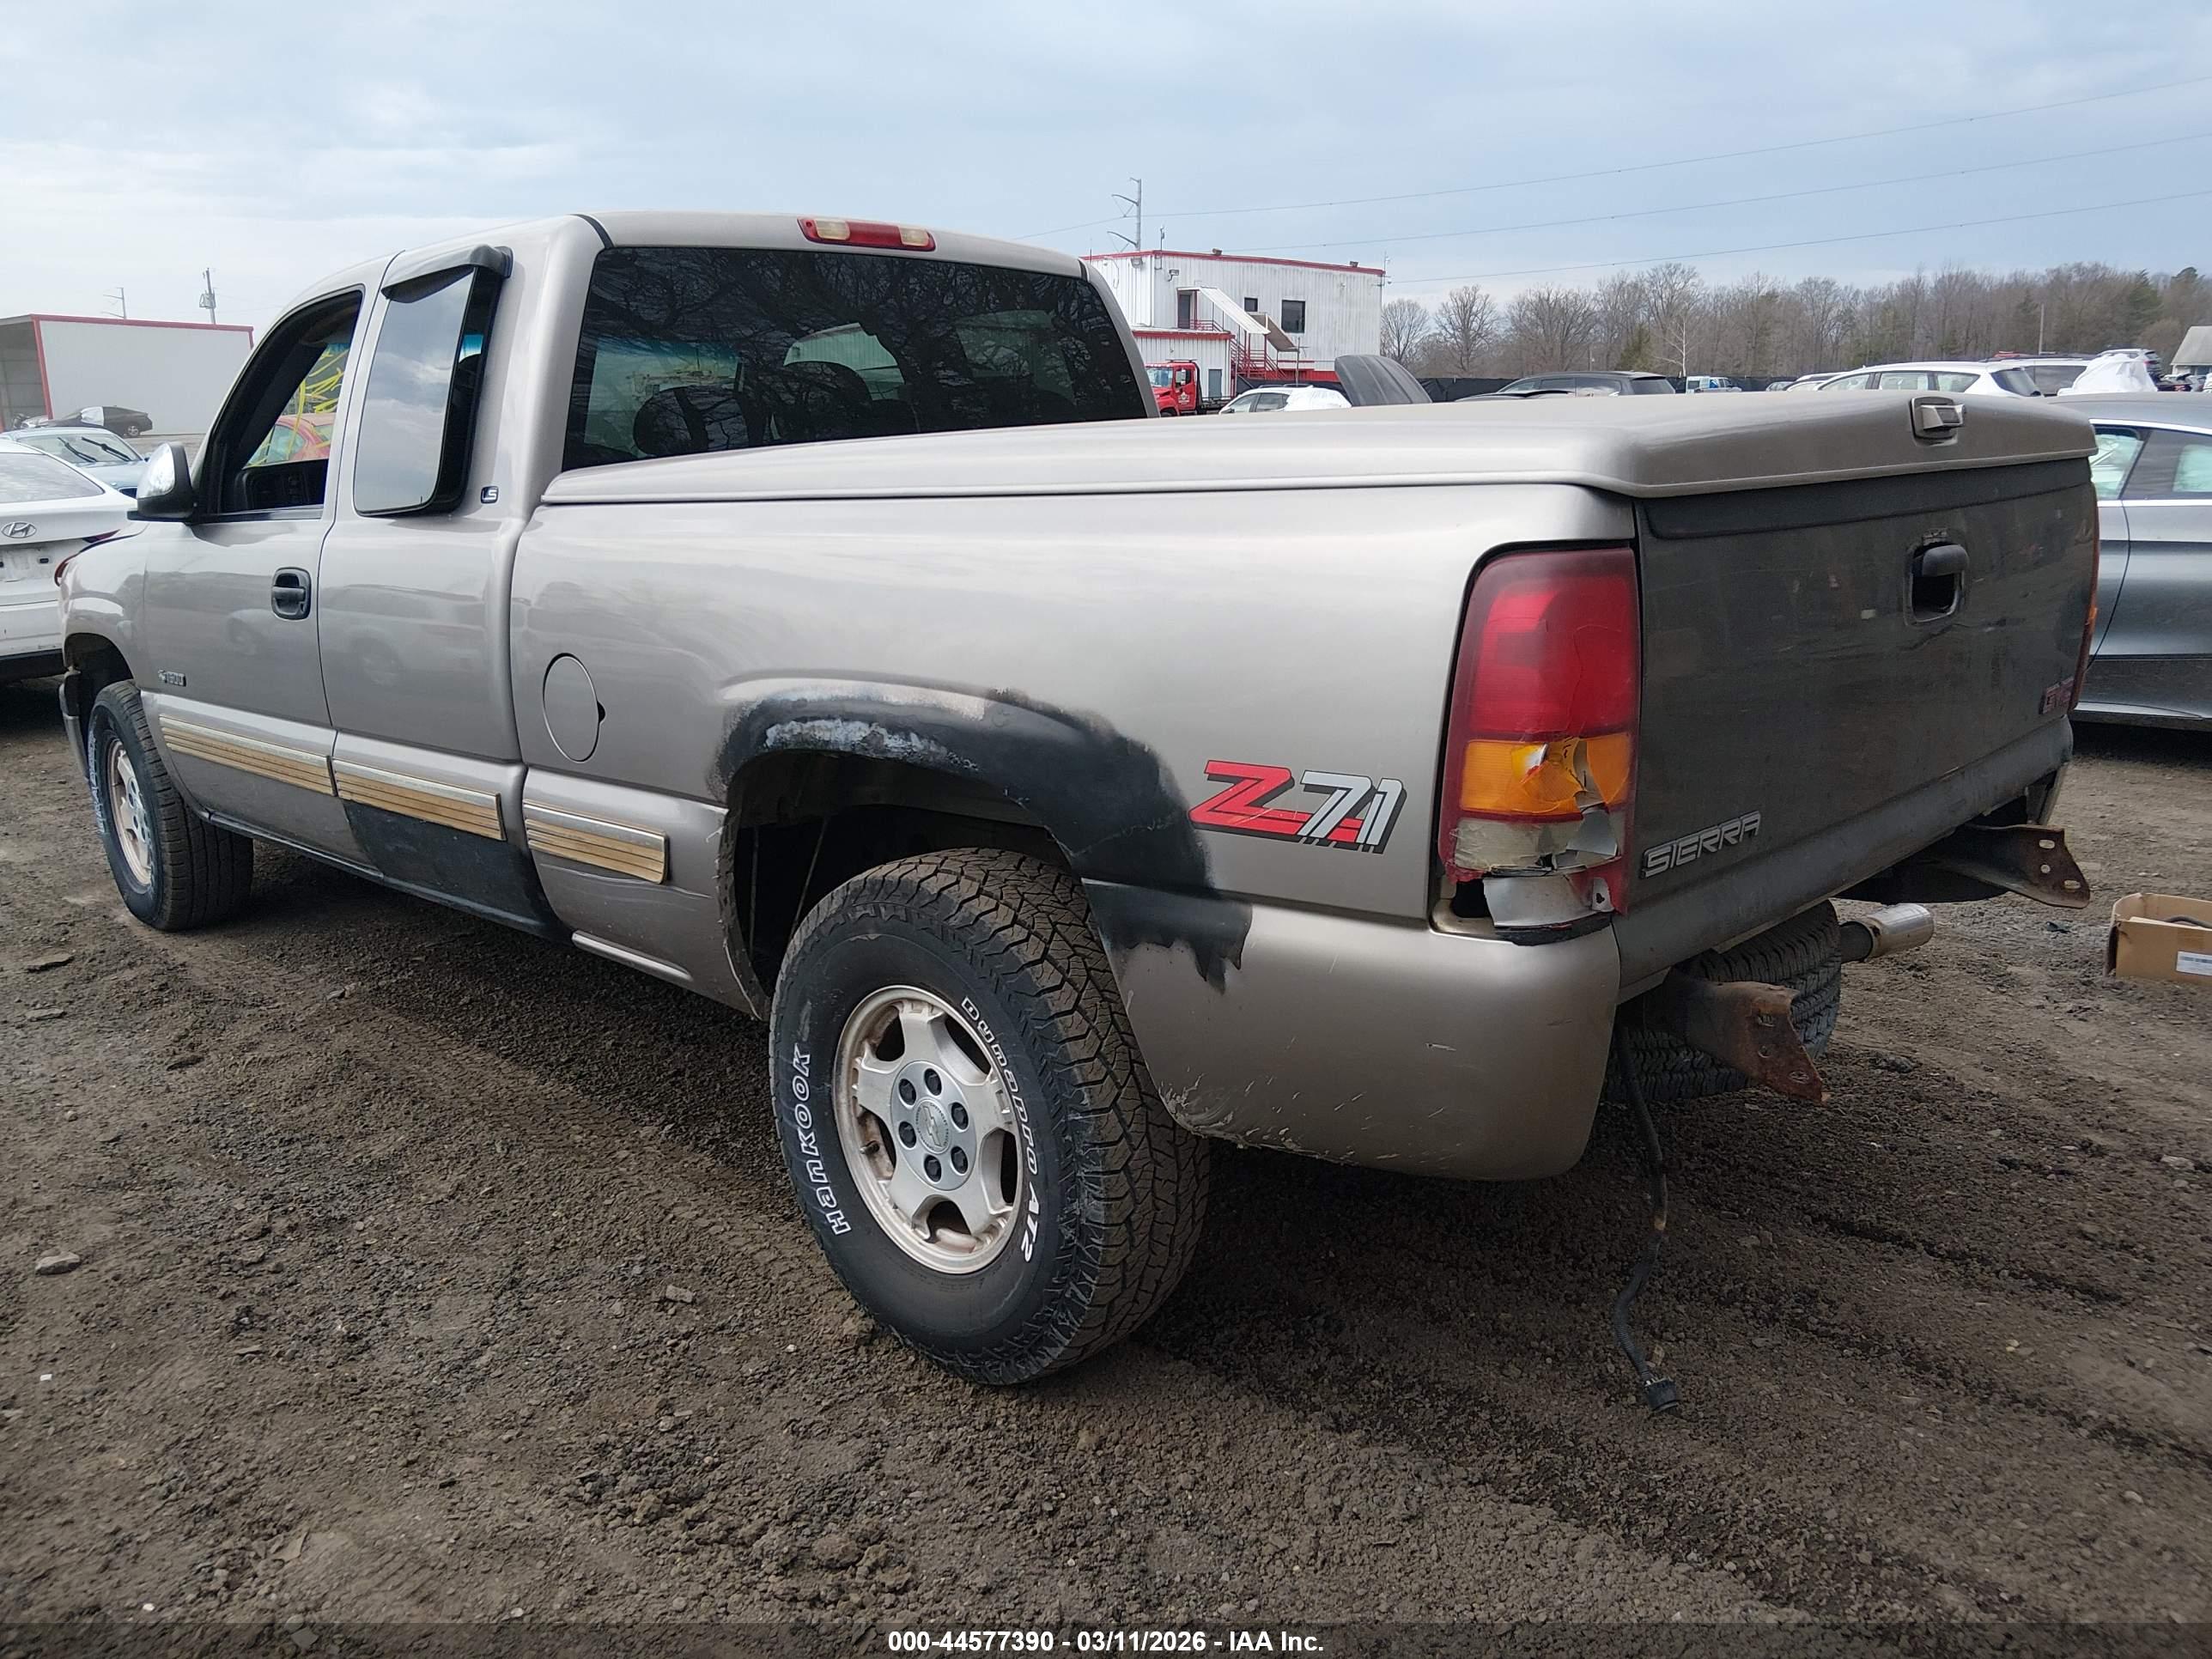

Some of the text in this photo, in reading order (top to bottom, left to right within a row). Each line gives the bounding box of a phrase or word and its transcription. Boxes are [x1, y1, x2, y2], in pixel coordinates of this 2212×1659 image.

[1188, 760, 1407, 854] Z71
[1639, 811, 1761, 879] SIERRA
[1020, 1182, 1040, 1263] AT2
